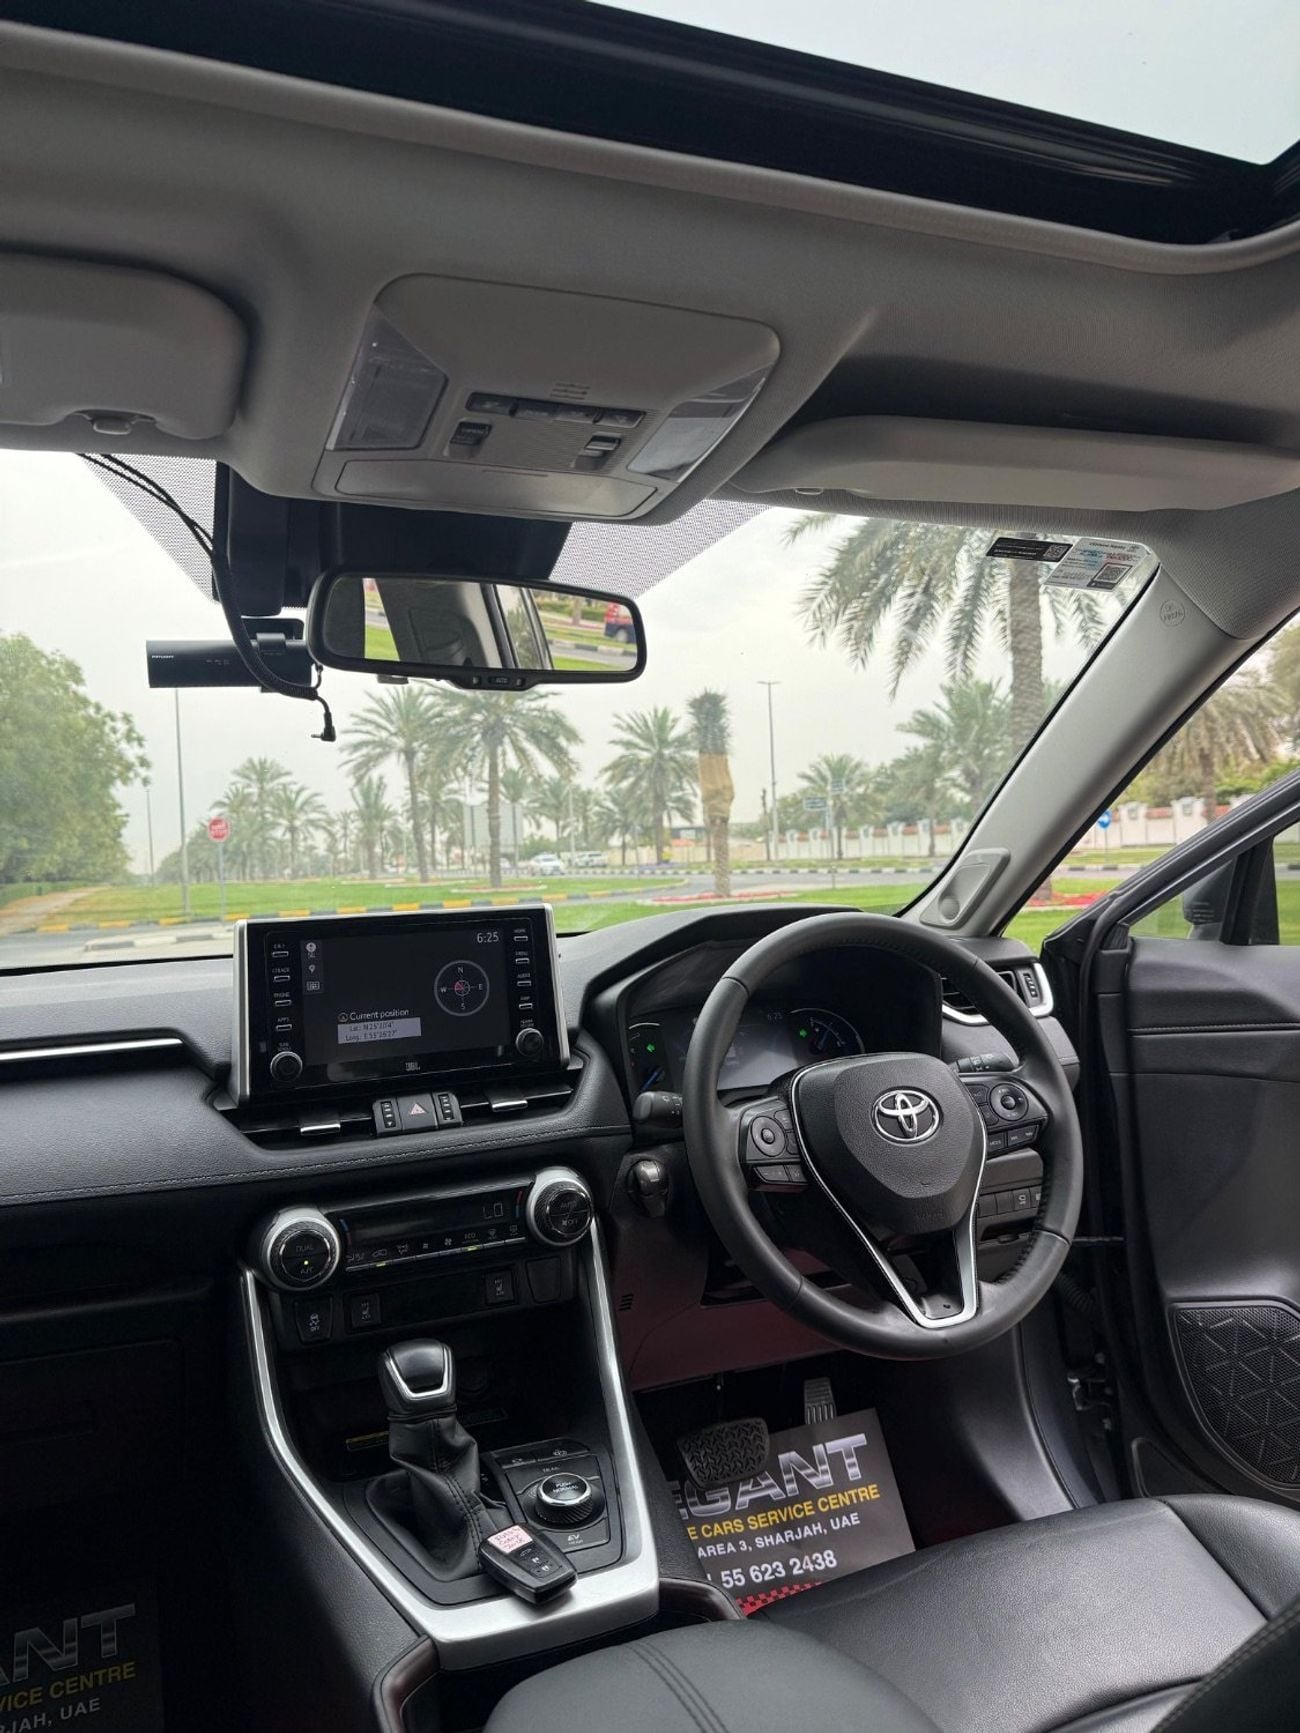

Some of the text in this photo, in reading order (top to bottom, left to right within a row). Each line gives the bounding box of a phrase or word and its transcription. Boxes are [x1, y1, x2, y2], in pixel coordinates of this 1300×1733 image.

[476, 931, 500, 944] 6:25
[350, 1007, 410, 1021] Current position
[671, 1433, 868, 1520] GANT
[701, 1518, 745, 1539] CARS
[747, 1503, 814, 1531] SERVICE
[819, 1484, 881, 1513] CENTRE
[697, 1541, 737, 1558] AREA
[754, 1522, 828, 1549] SHARJAH,
[830, 1512, 861, 1531] UAE
[720, 1568, 746, 1589] 55
[749, 1560, 786, 1584] 623
[791, 1550, 838, 1576] 2438
[0, 1604, 136, 1685] NT
[50, 1662, 137, 1699] CENTRE
[60, 1698, 100, 1720] UAE
